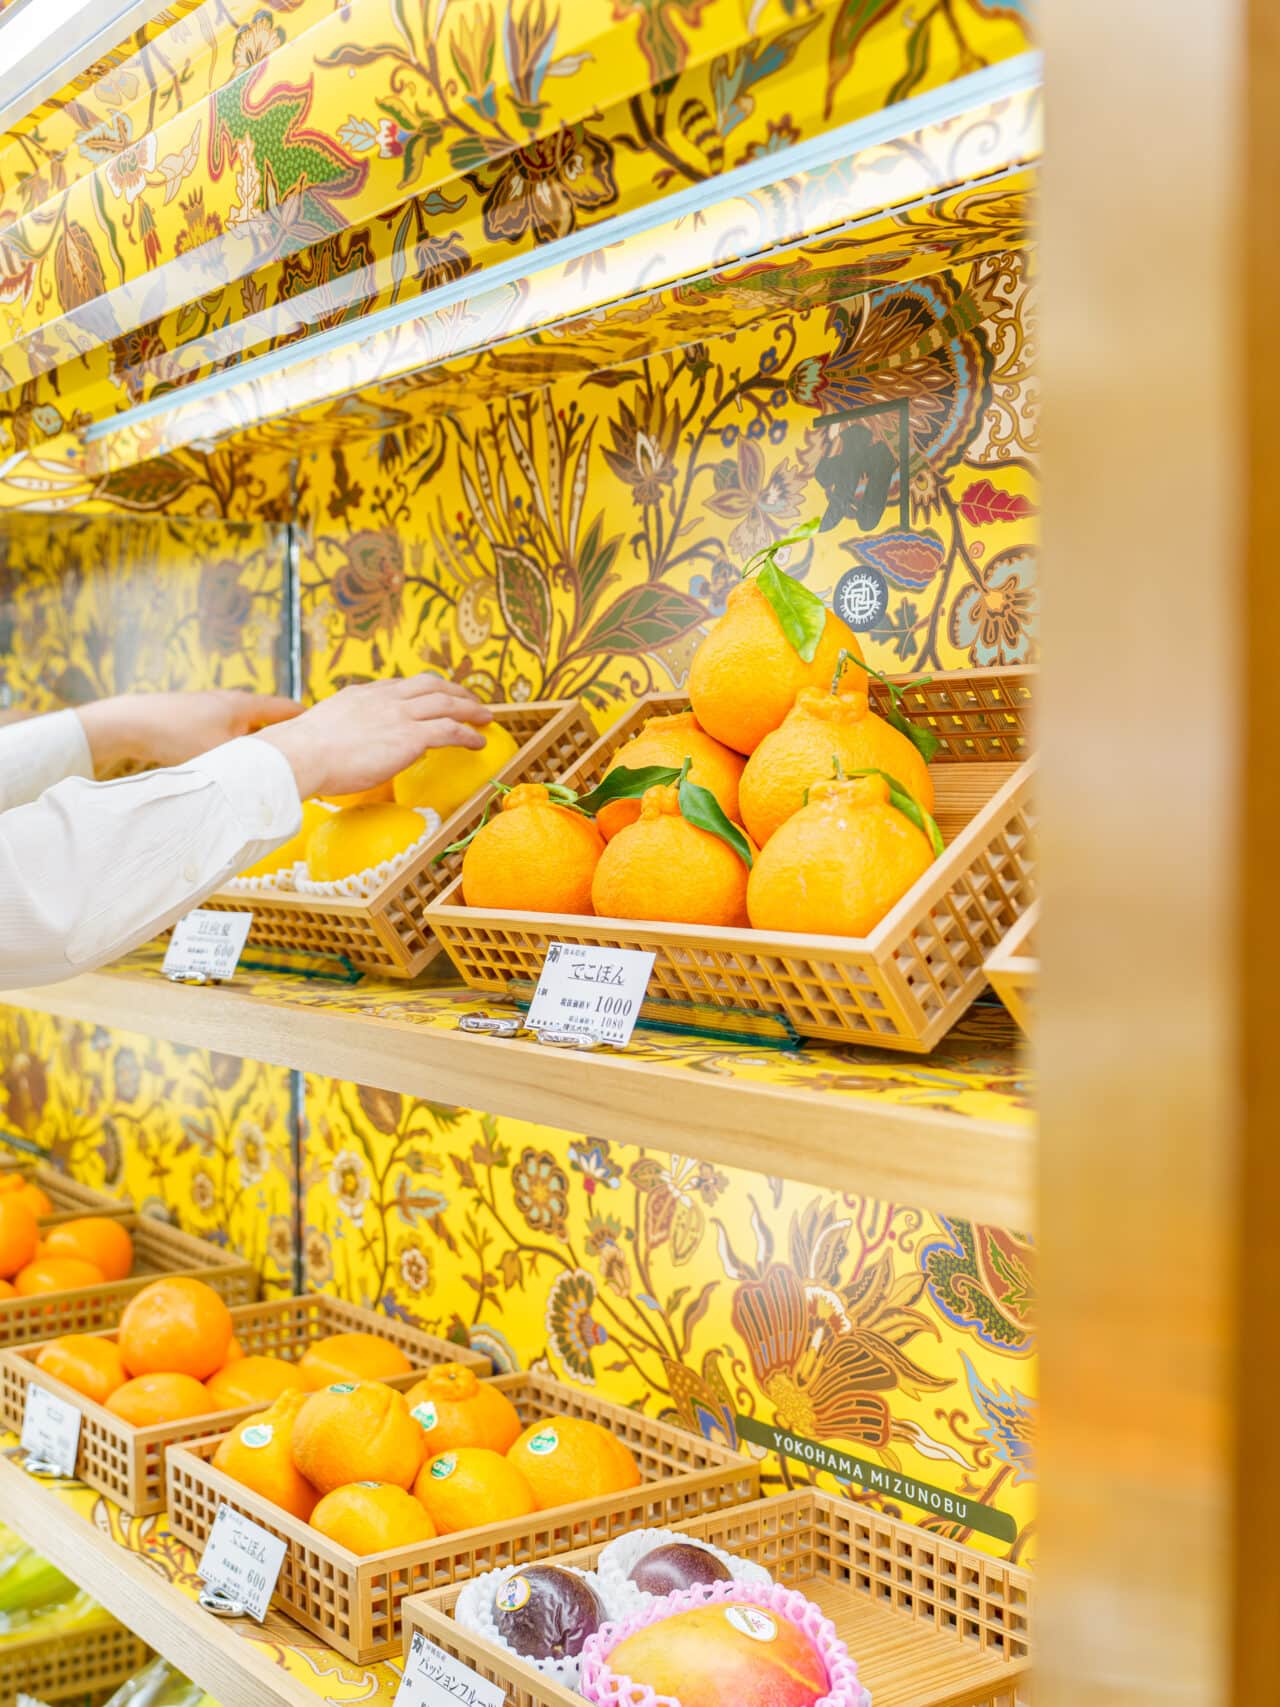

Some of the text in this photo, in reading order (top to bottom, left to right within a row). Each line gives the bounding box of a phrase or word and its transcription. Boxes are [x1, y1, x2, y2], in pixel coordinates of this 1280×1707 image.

[840, 573, 882, 600] YOKOHAMA
[595, 995, 632, 1017] 1000
[600, 1016, 624, 1030] 1080
[772, 1432, 968, 1519] YOKOHAMA MIZUNOBU
[247, 1567, 266, 1592] 600
